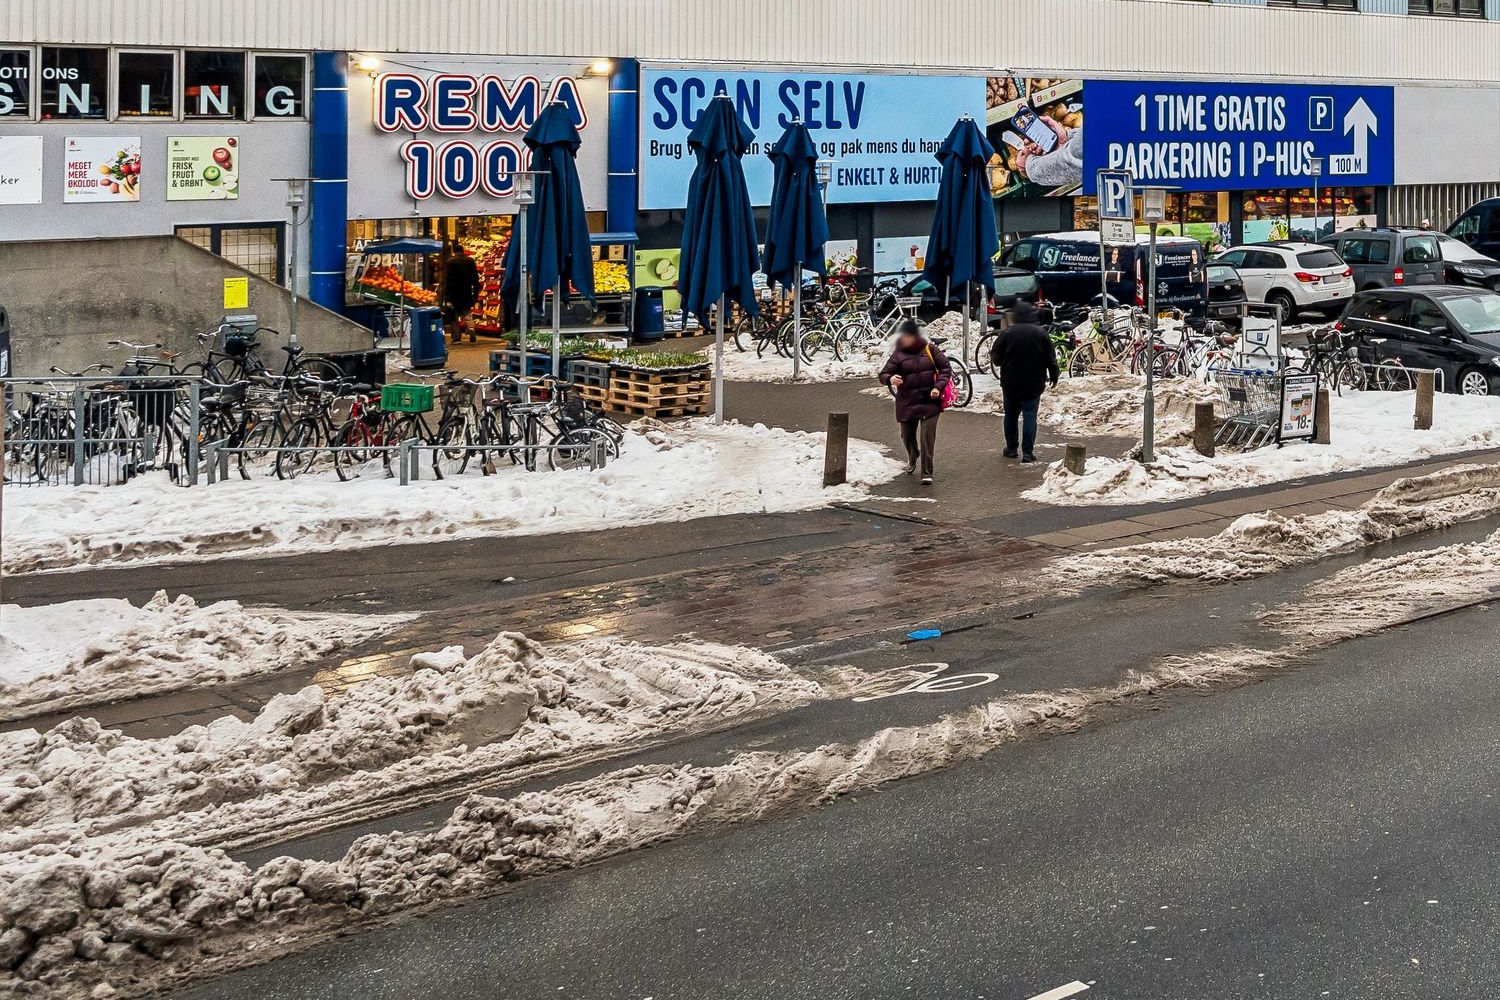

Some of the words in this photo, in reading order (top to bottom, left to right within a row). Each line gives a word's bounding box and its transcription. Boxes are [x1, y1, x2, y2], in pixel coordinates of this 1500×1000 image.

[374, 73, 588, 133] REMA
[777, 79, 866, 130] SELV
[1135, 95, 1146, 132] 1
[1154, 95, 1207, 132] TIME
[1213, 95, 1286, 132] GRATIS
[1316, 102, 1327, 126] P
[650, 140, 682, 160] Brug
[821, 142, 835, 157] og
[841, 138, 863, 157] pak
[866, 141, 898, 154] mens
[902, 138, 915, 154] du
[68, 161, 92, 170] MEGET
[172, 162, 193, 170] FRISK
[400, 139, 533, 200] 100
[1109, 142, 1231, 180] PARKERING
[1239, 141, 1245, 177] I
[1253, 141, 1315, 177] P-HUS
[1335, 158, 1351, 173] 100
[1355, 158, 1361, 172] M
[68, 170, 88, 179] MERE
[68, 179, 98, 188] ØKOLOGI
[172, 170, 195, 179] FRUGT
[172, 179, 178, 188] &
[180, 179, 204, 187] GRØNT
[837, 167, 885, 186] ENKELT
[890, 168, 899, 185] &
[1105, 178, 1125, 212] P
[1061, 252, 1100, 262] Freelancer
